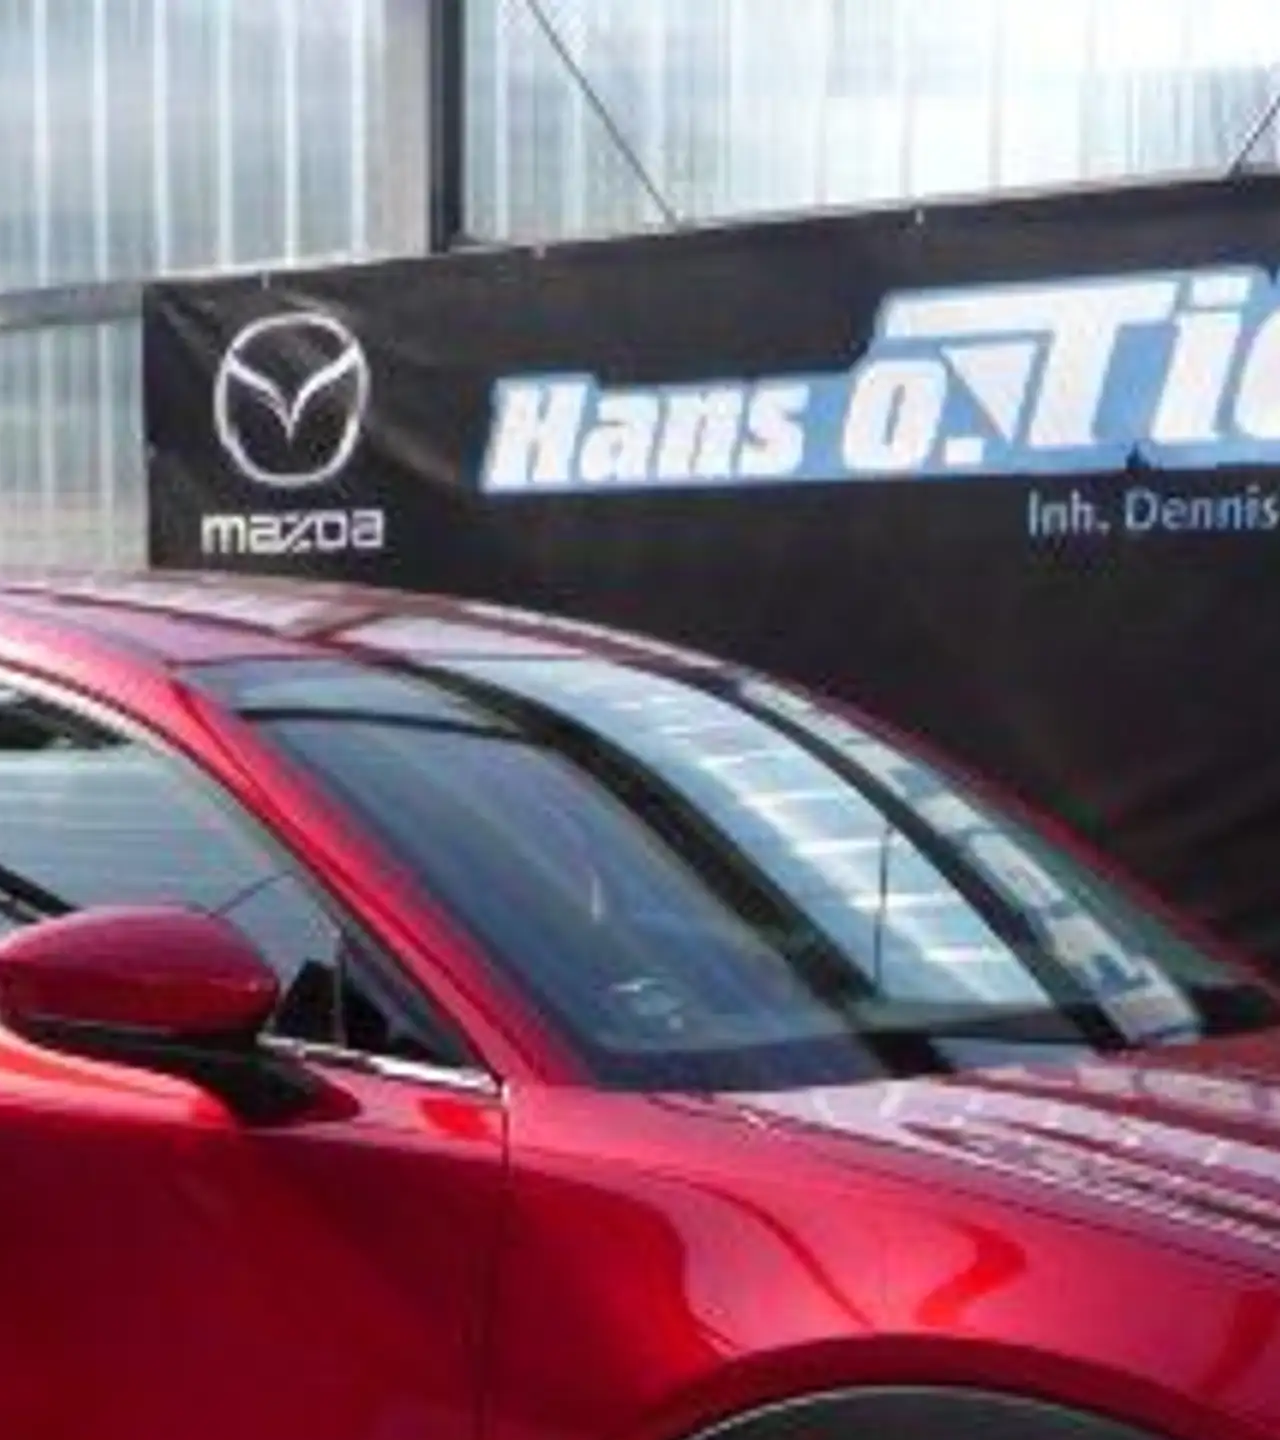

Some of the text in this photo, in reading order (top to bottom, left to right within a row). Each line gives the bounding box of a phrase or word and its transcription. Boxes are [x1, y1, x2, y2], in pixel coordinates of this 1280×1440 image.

[488, 374, 810, 487] Hans
[840, 358, 986, 472] O.
[200, 508, 386, 556] mazda
[1026, 488, 1110, 536] Inh.
[1124, 486, 1280, 534] Dennis
